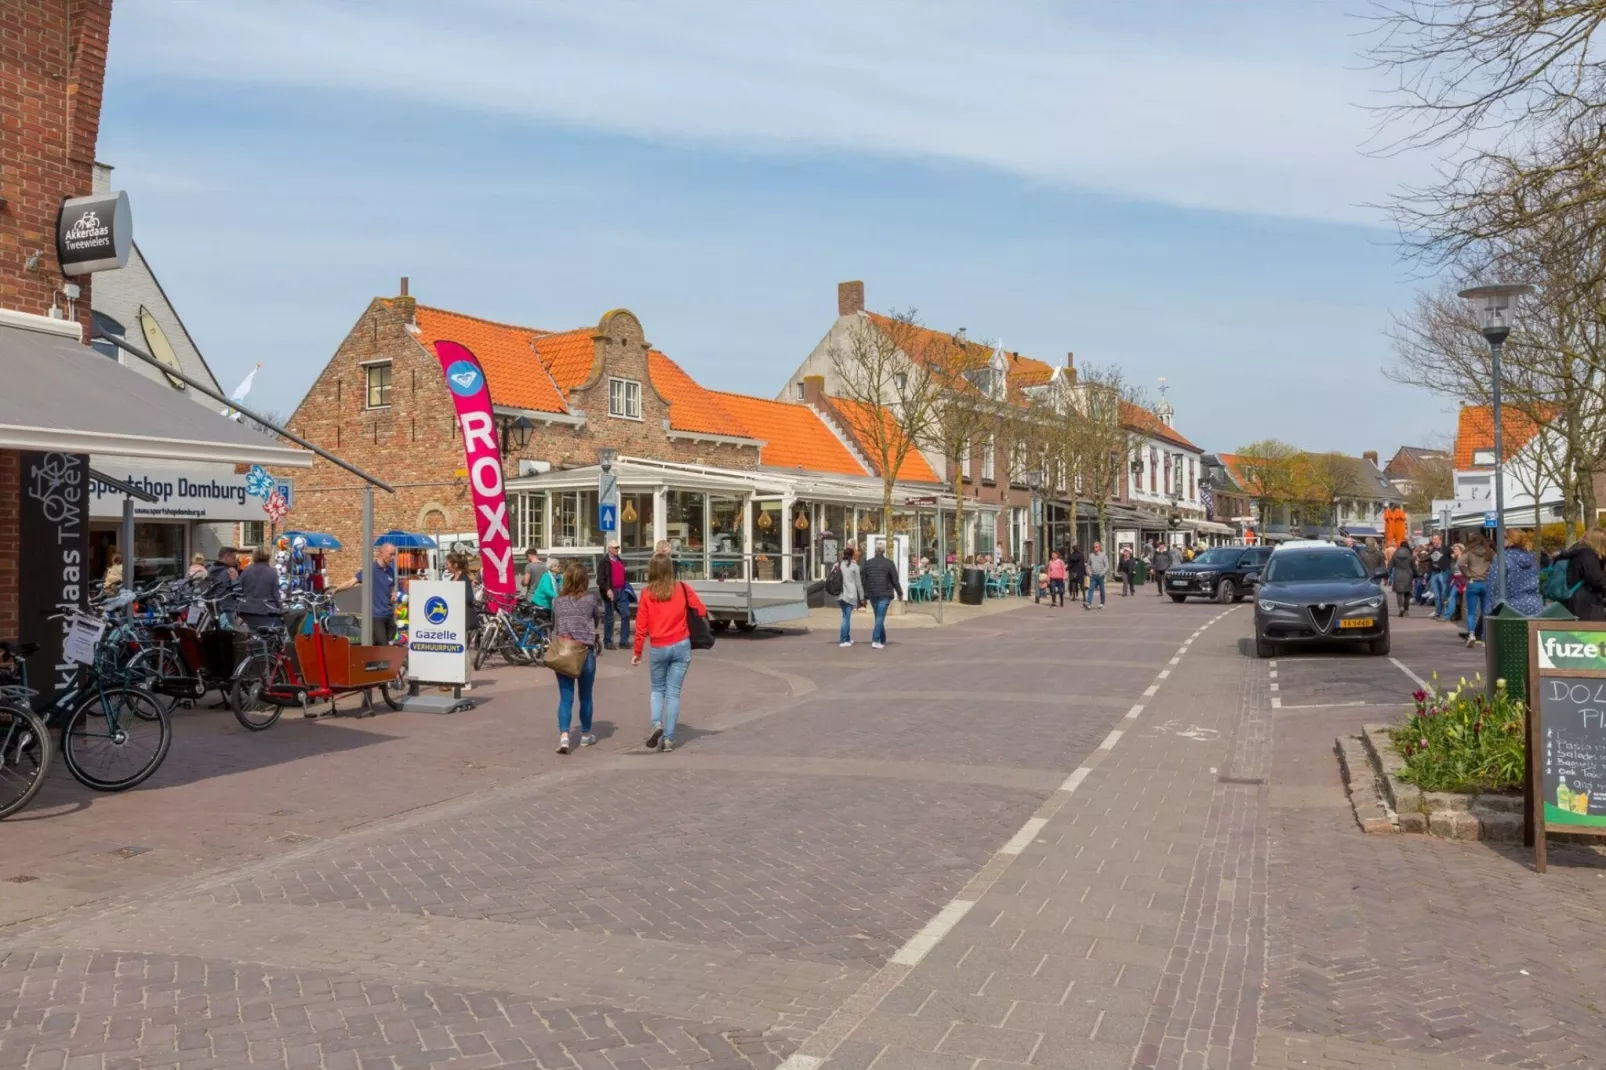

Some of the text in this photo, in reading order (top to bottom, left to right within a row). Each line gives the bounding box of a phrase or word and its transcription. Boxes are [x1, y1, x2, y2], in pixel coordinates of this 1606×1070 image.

[65, 226, 109, 241] Akkerdaas
[65, 236, 110, 250] Tweewielers
[178, 477, 246, 505] Domburg
[460, 411, 512, 584] ROXY
[415, 630, 457, 640] Gazelle
[413, 643, 460, 652] VERHUURPUNT
